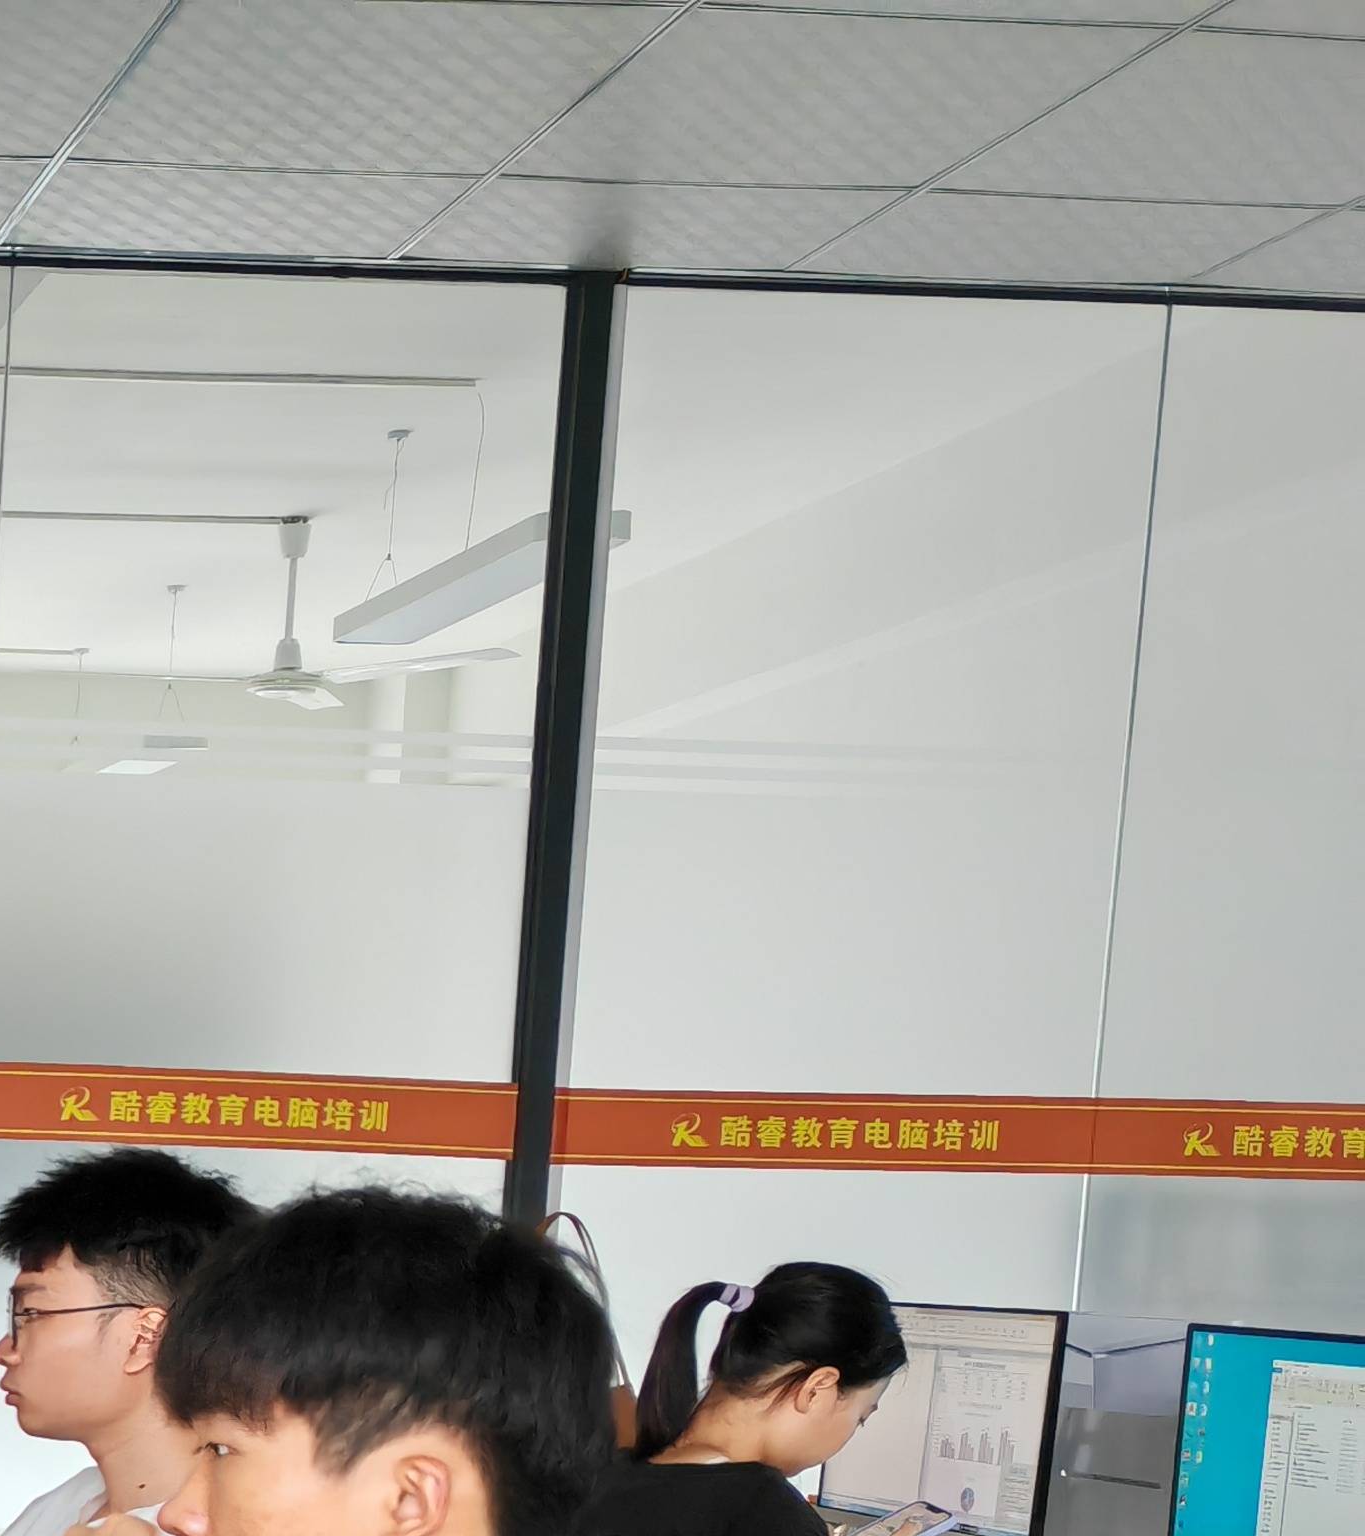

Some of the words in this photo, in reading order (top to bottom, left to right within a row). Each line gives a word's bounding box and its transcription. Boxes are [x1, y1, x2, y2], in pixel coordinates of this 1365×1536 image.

[109, 1091, 390, 1132] 酷睿教育电脑培训
[719, 1116, 1001, 1151] 酷睿教育电脑培训
[1233, 1125, 1365, 1160] 酷睿教育
